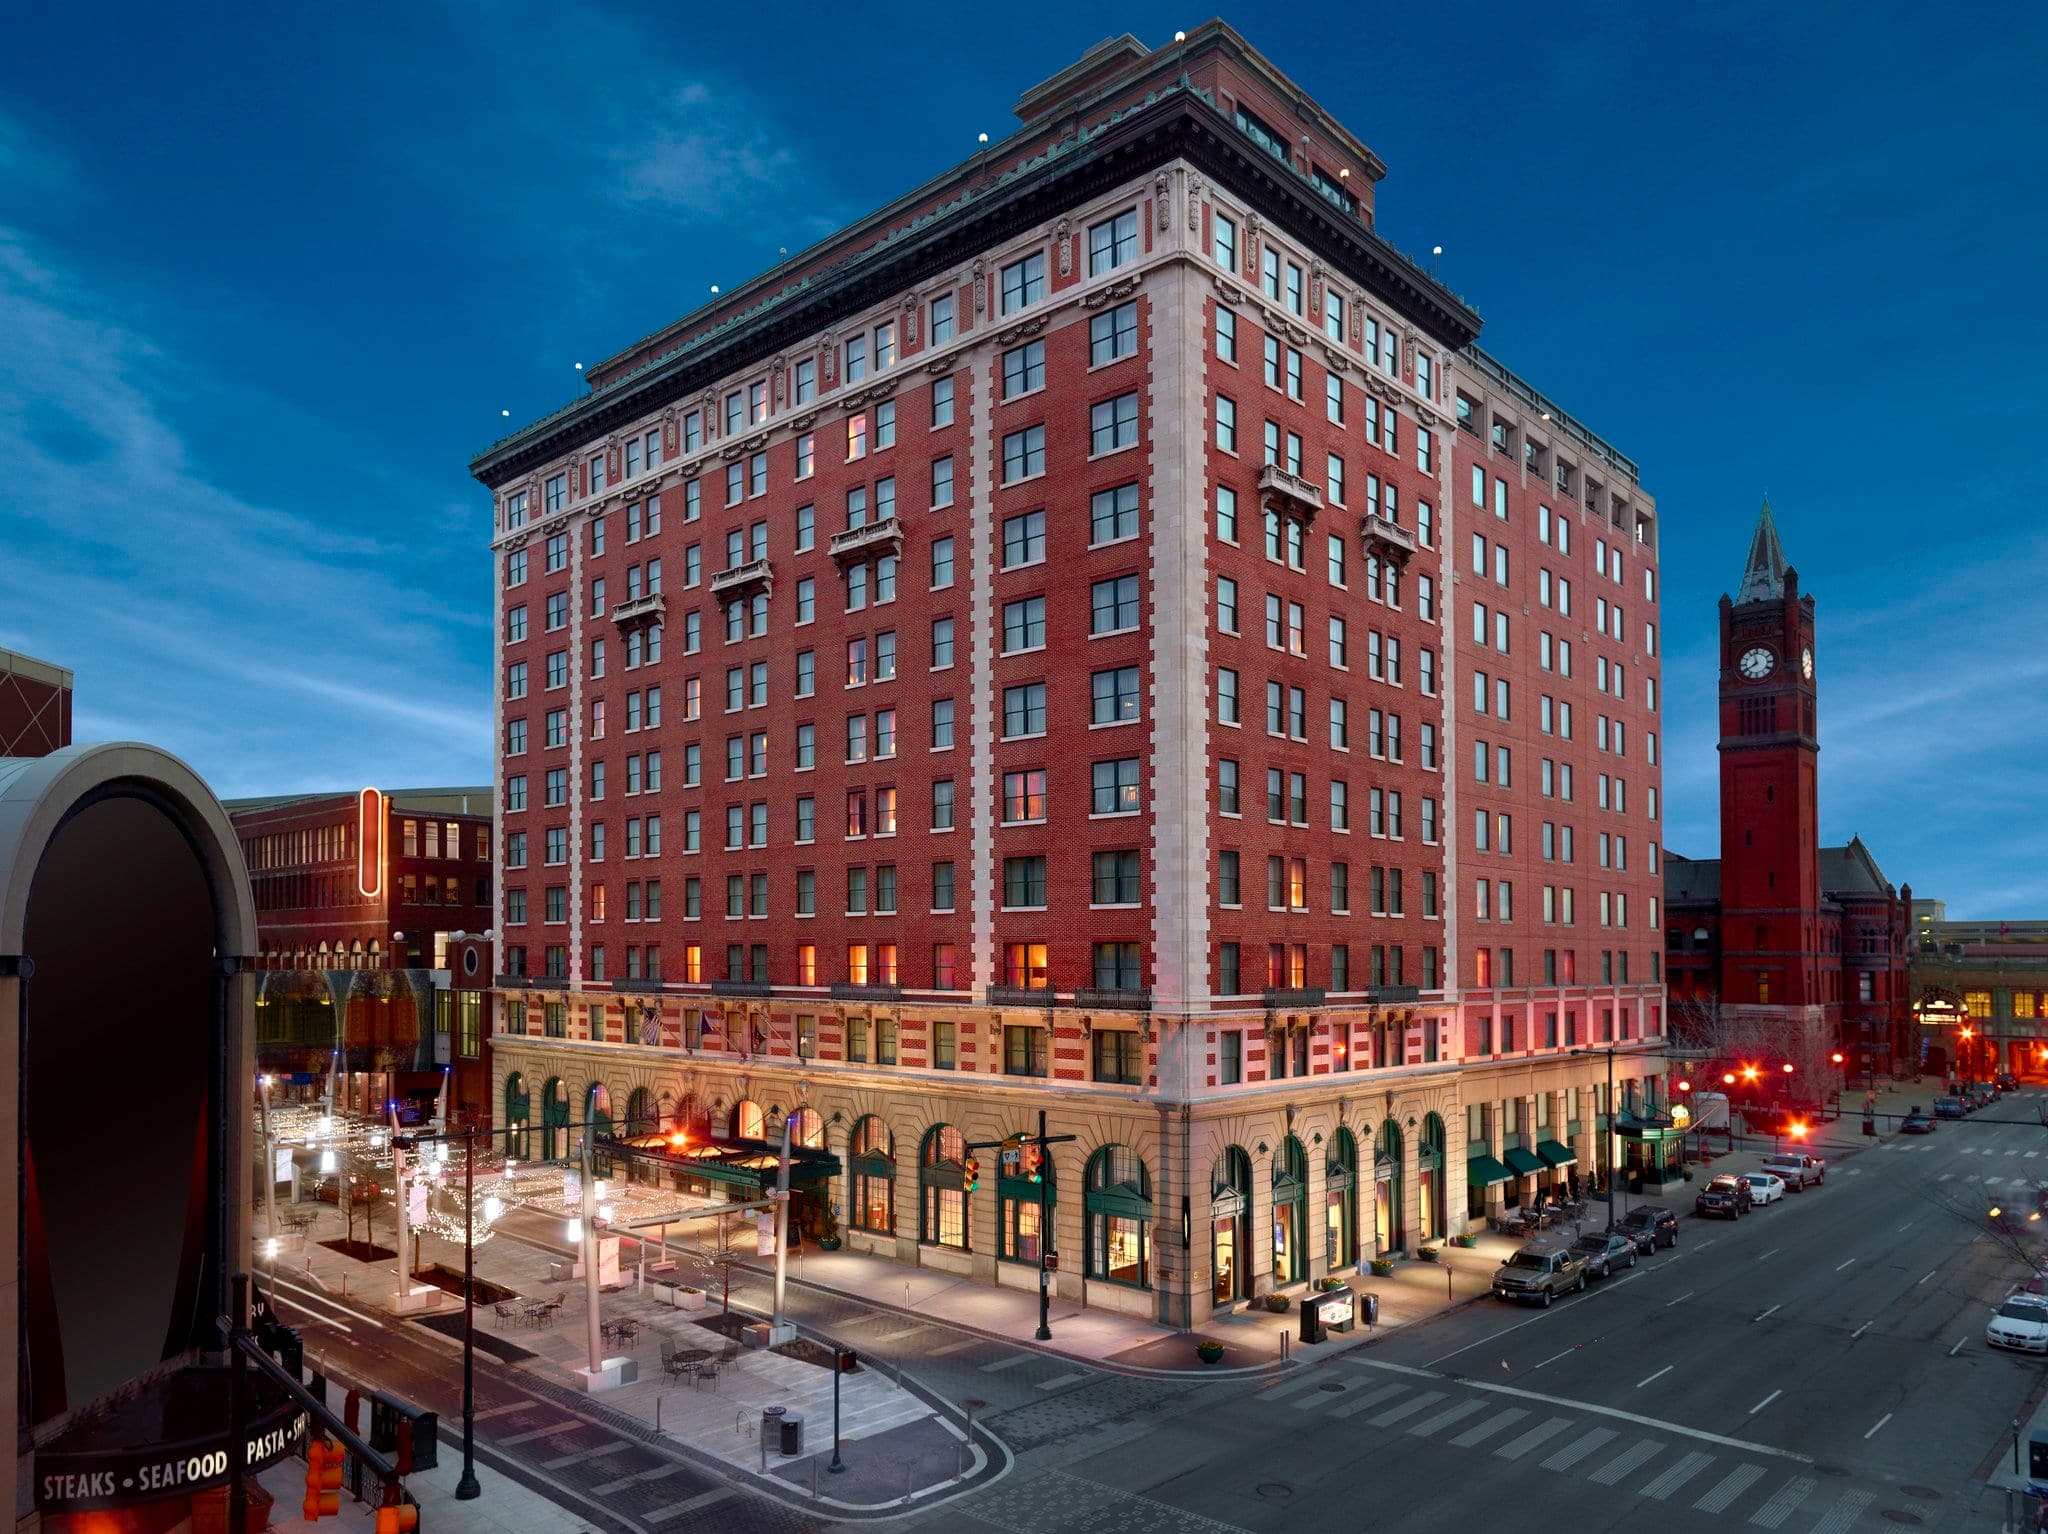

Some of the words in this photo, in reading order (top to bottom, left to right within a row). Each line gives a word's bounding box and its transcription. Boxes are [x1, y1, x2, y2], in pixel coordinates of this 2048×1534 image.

[43, 1470, 116, 1501] STEAKS
[138, 1449, 228, 1492] SEAFOOD
[246, 1427, 285, 1465] PASTA
